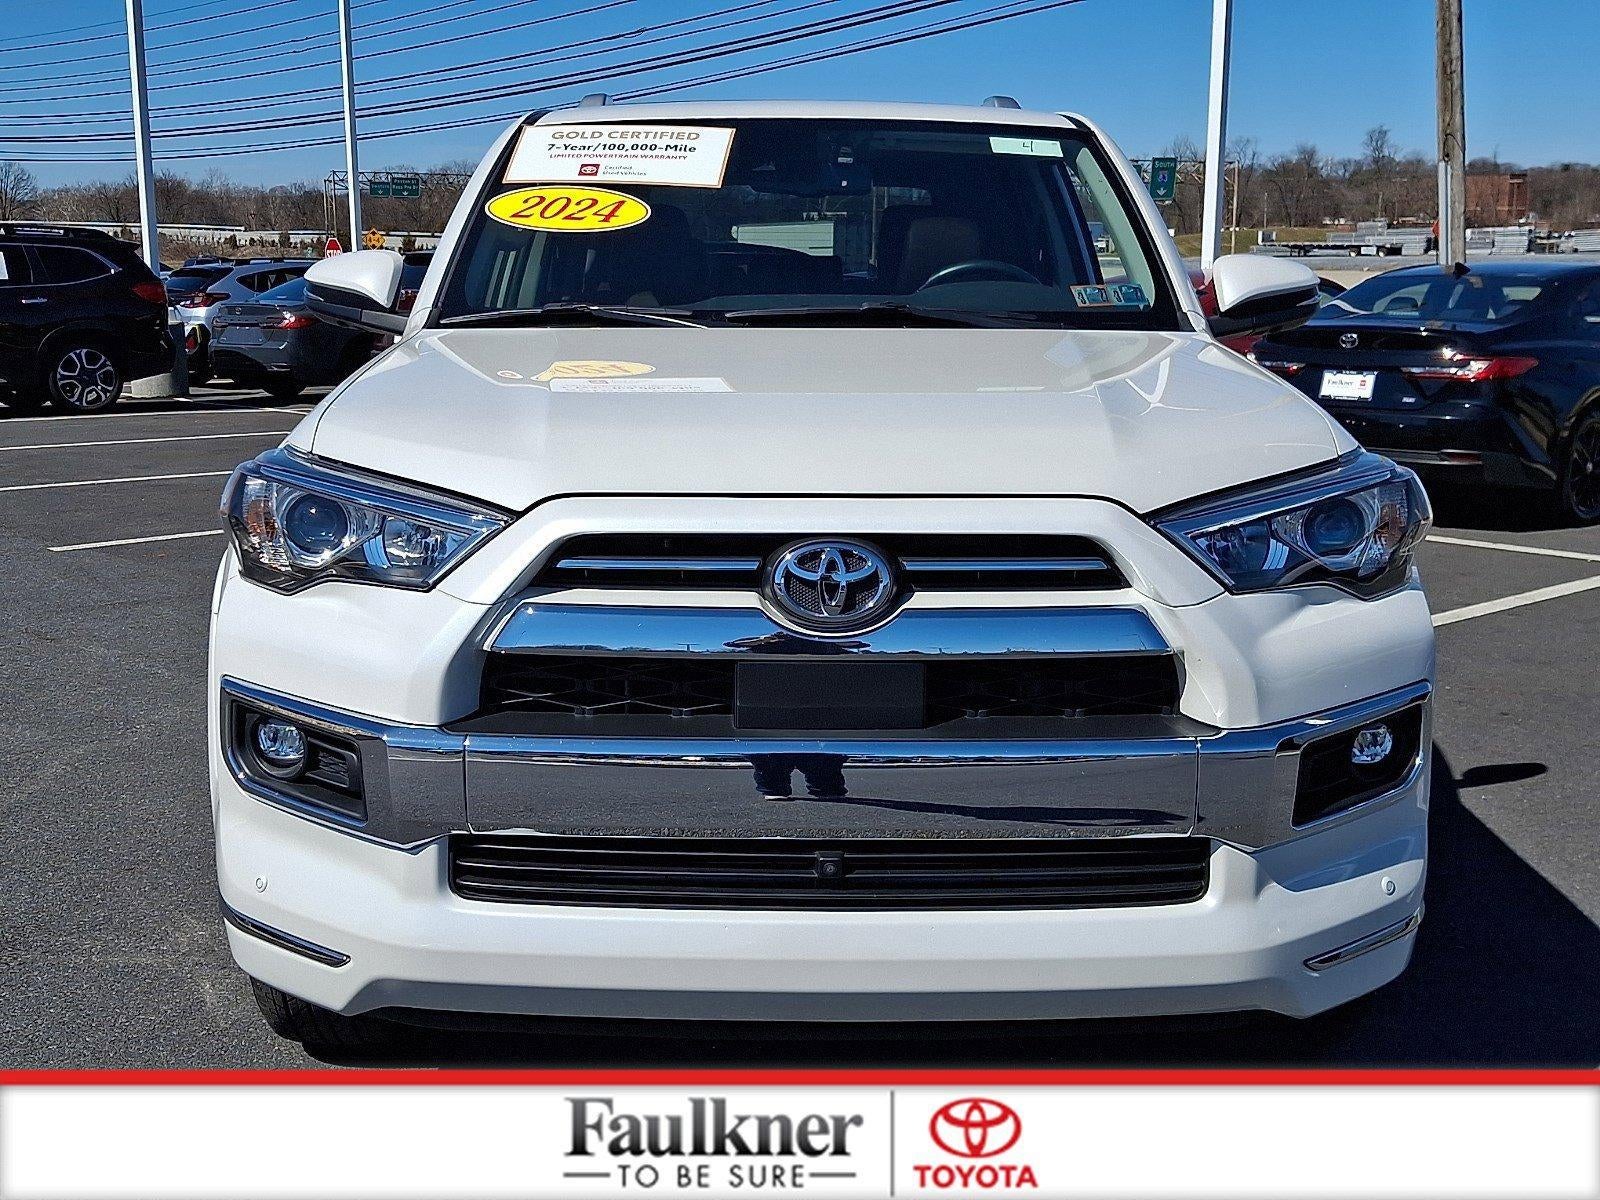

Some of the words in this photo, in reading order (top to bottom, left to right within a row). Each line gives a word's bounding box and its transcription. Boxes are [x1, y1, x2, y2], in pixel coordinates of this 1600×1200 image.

[551, 131, 604, 140] GOLD
[607, 131, 701, 141] CERTIFIED
[547, 142, 697, 153] 7-Year/100,000-Mile
[510, 194, 629, 223] 2024
